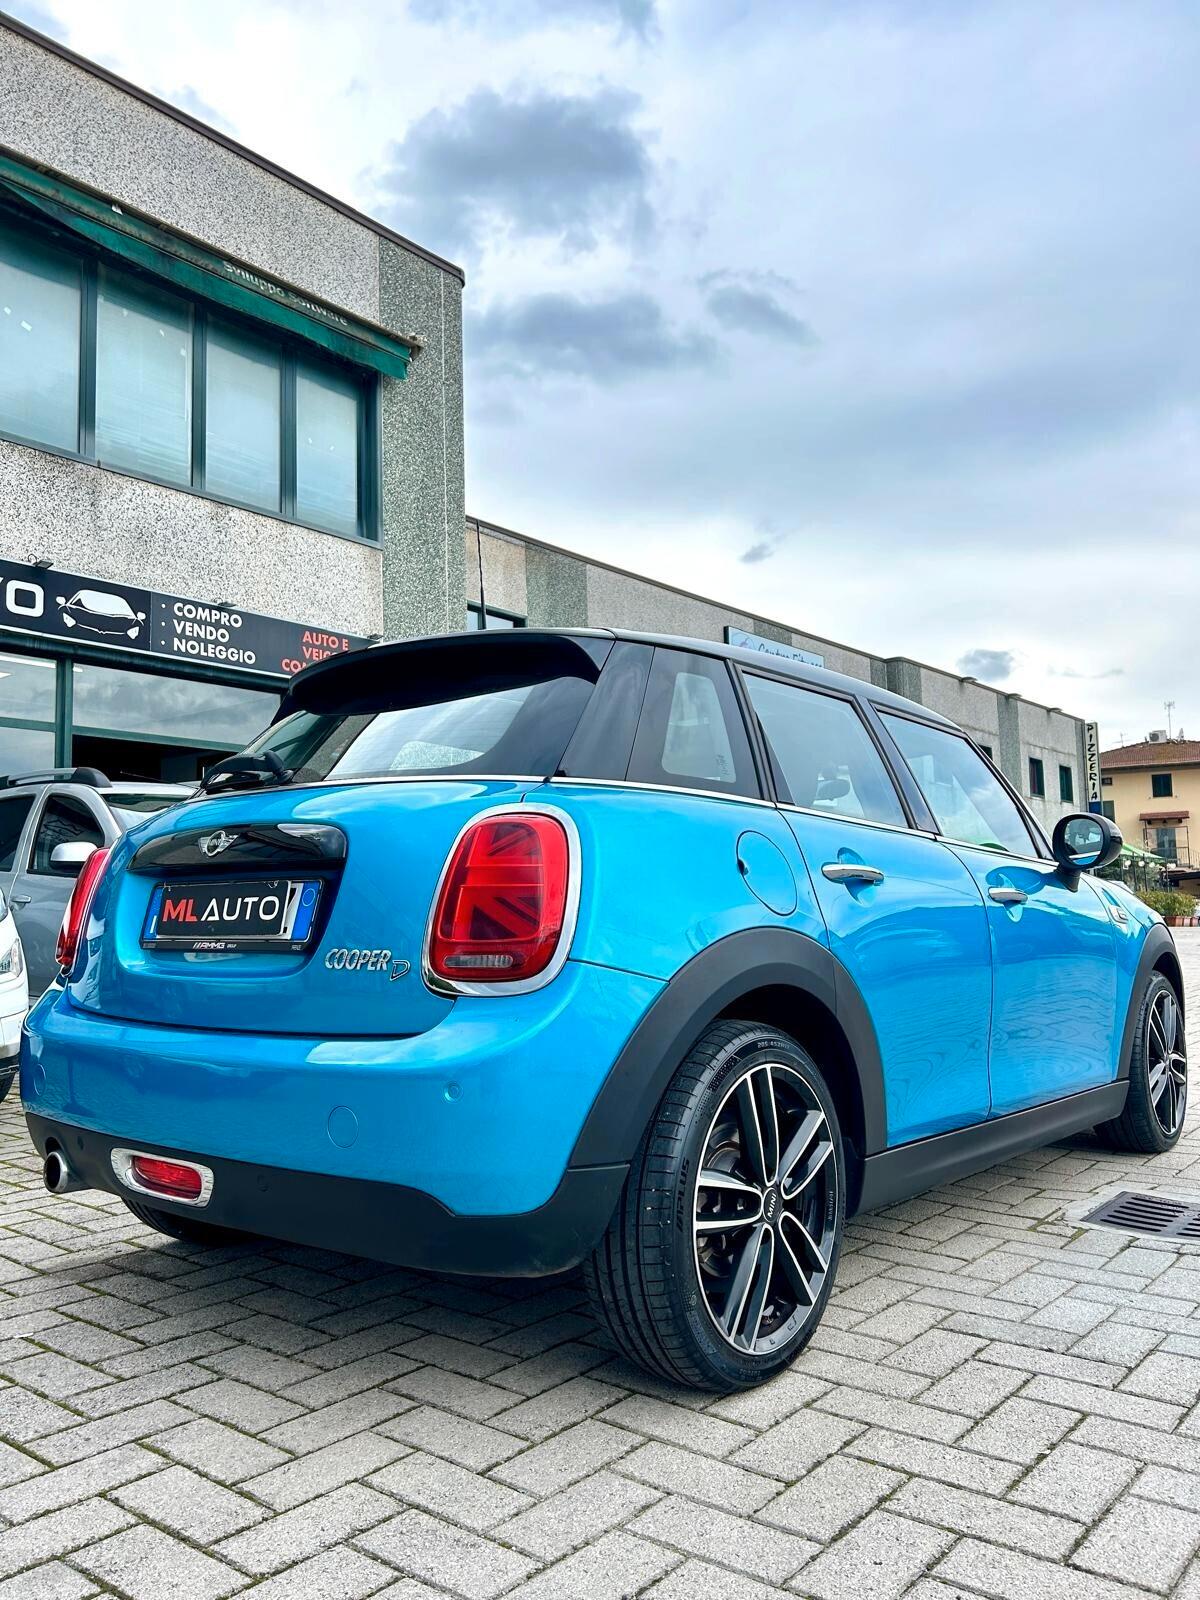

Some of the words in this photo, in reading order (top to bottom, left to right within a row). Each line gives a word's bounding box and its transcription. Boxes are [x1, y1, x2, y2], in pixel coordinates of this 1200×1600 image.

[0, 577, 44, 617] O
[173, 602, 243, 628] COMPRO
[172, 618, 230, 643] VENDO
[302, 630, 339, 649] AUTO
[342, 638, 349, 651] E
[173, 637, 256, 665] NOLEGGIO
[302, 646, 337, 661] VEIC
[1086, 724, 1098, 801] PIZZERIA
[162, 898, 198, 922] ML
[200, 895, 280, 921] AUTO
[325, 948, 392, 971] COOPER
[389, 959, 411, 982] D
[767, 1193, 777, 1218] MINI
